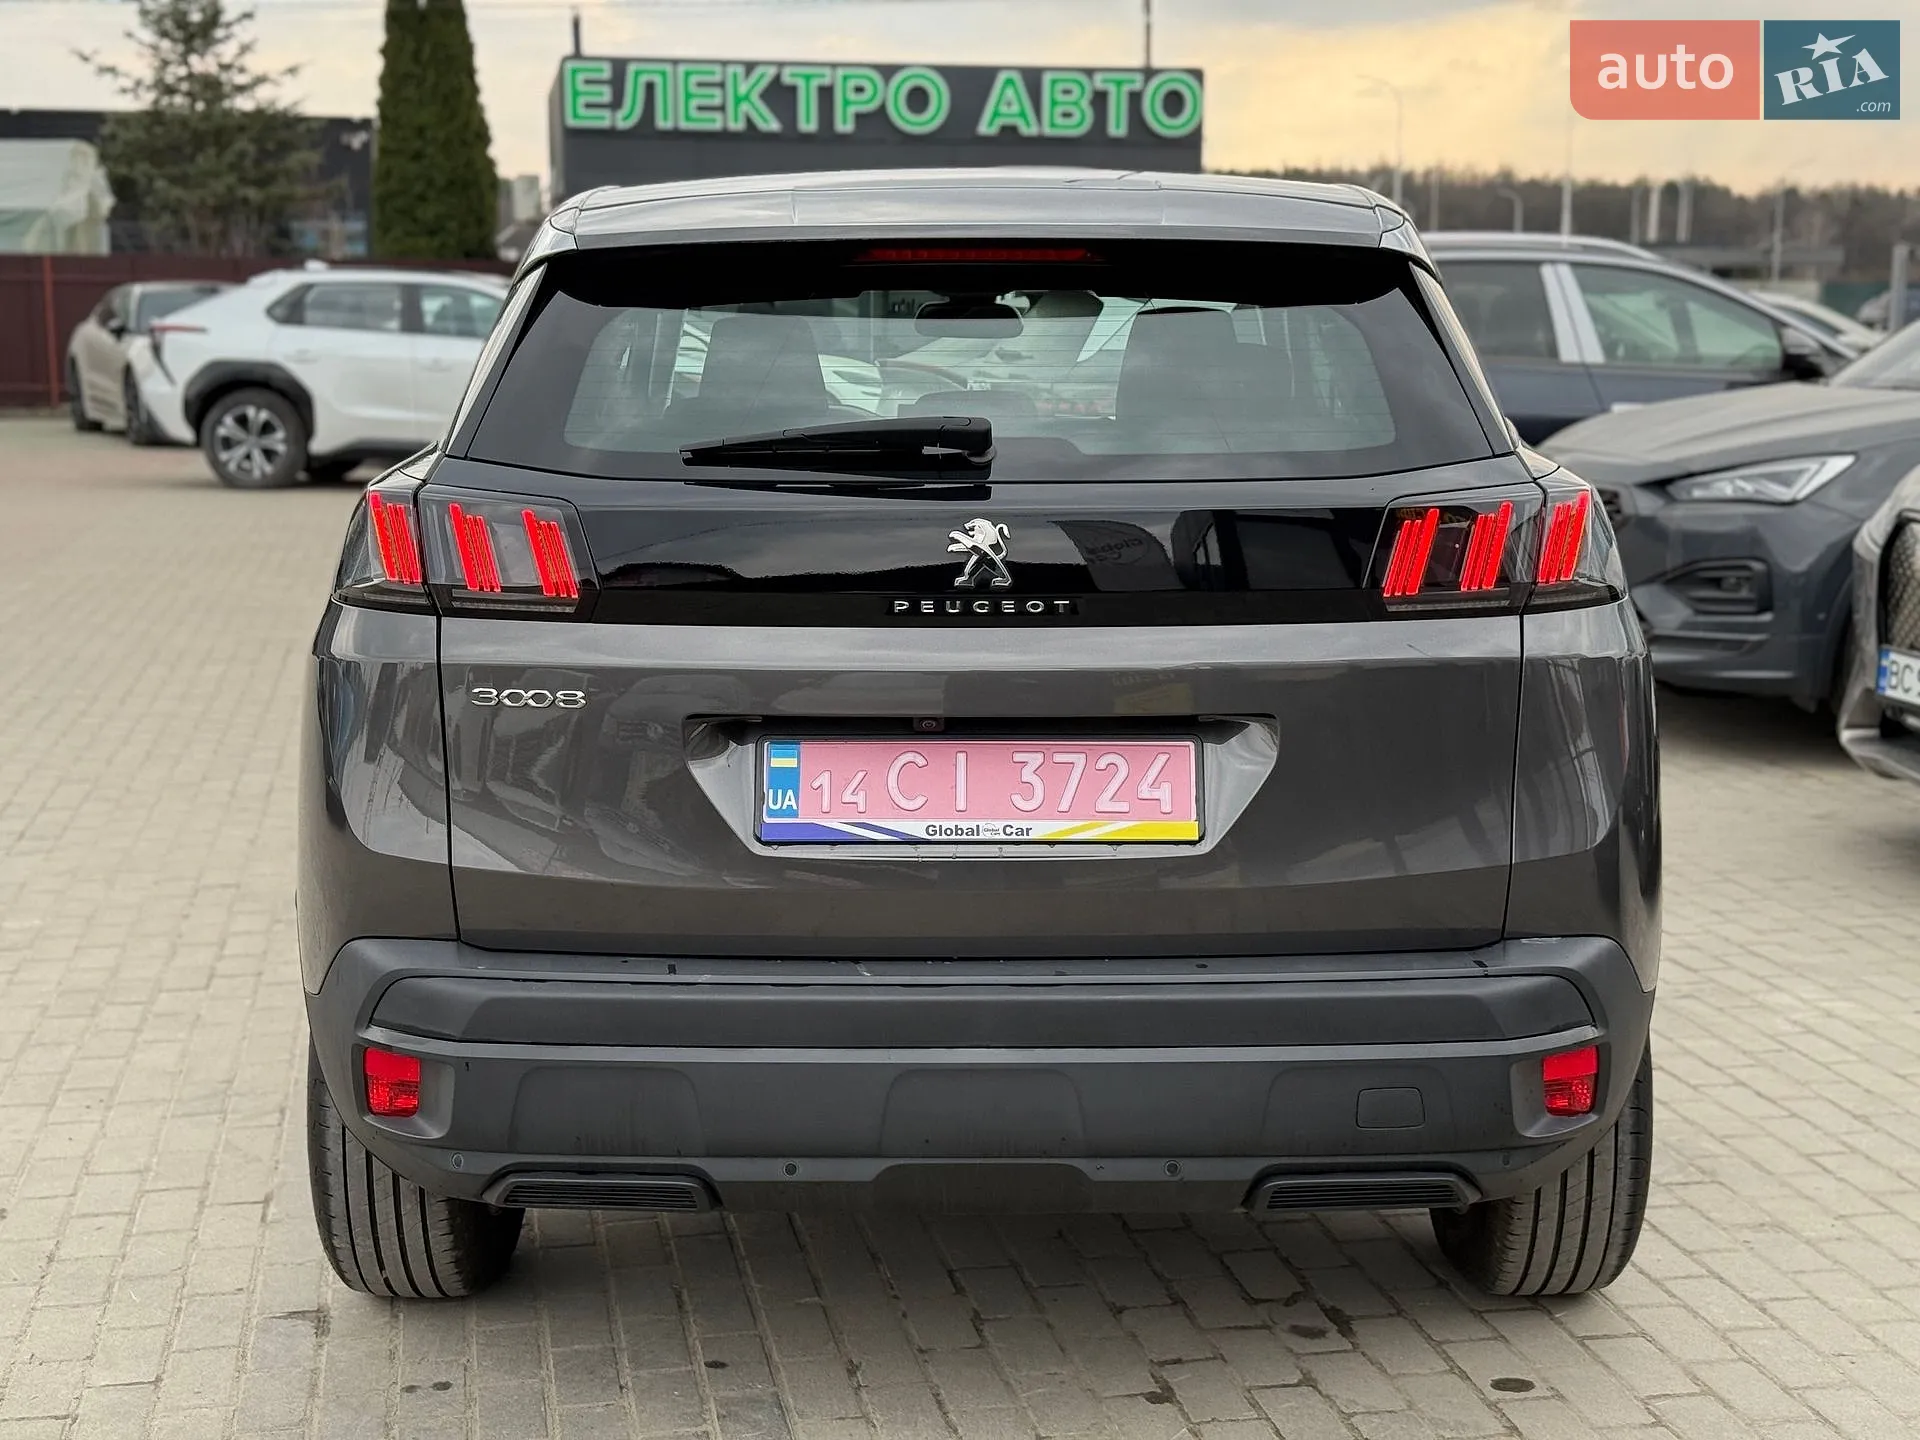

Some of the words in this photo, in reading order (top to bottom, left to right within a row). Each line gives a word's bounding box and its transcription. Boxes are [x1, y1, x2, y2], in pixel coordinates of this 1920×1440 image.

[563, 59, 950, 135] ЕЛЕКТРО
[978, 67, 1204, 138] АВТО
[894, 600, 1070, 613] PEUGEOT
[471, 687, 587, 709] 3008
[809, 769, 868, 814] 14
[1010, 751, 1173, 815] 3724
[768, 788, 797, 811] UA
[925, 824, 980, 837] Global
[1002, 824, 1033, 837] Car
